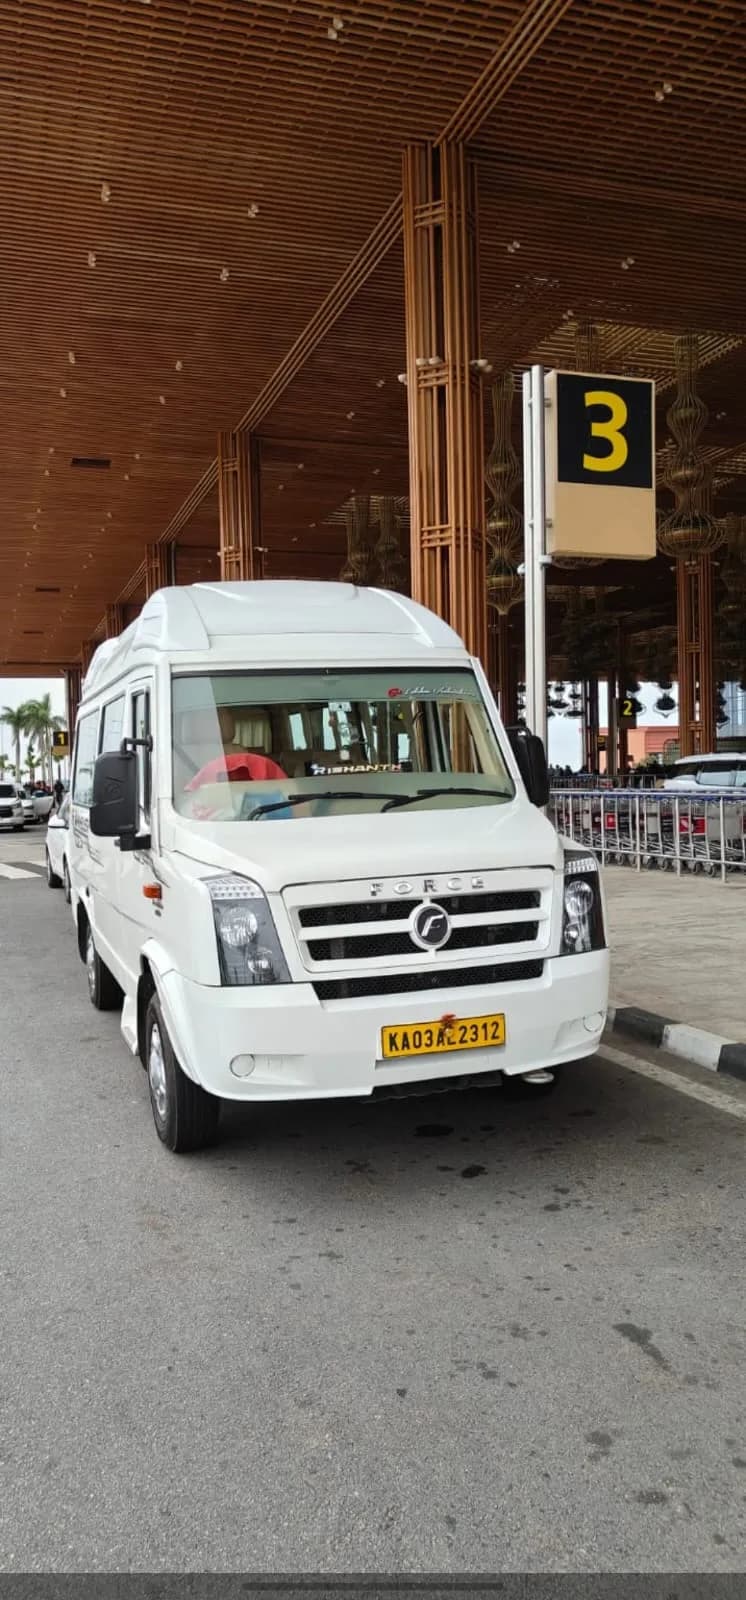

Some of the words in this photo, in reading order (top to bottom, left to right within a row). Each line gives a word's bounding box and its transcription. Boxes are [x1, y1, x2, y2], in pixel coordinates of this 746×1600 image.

[583, 390, 628, 472] 3
[623, 700, 633, 716] 2
[57, 733, 65, 745] 1
[370, 876, 484, 896] FORCE
